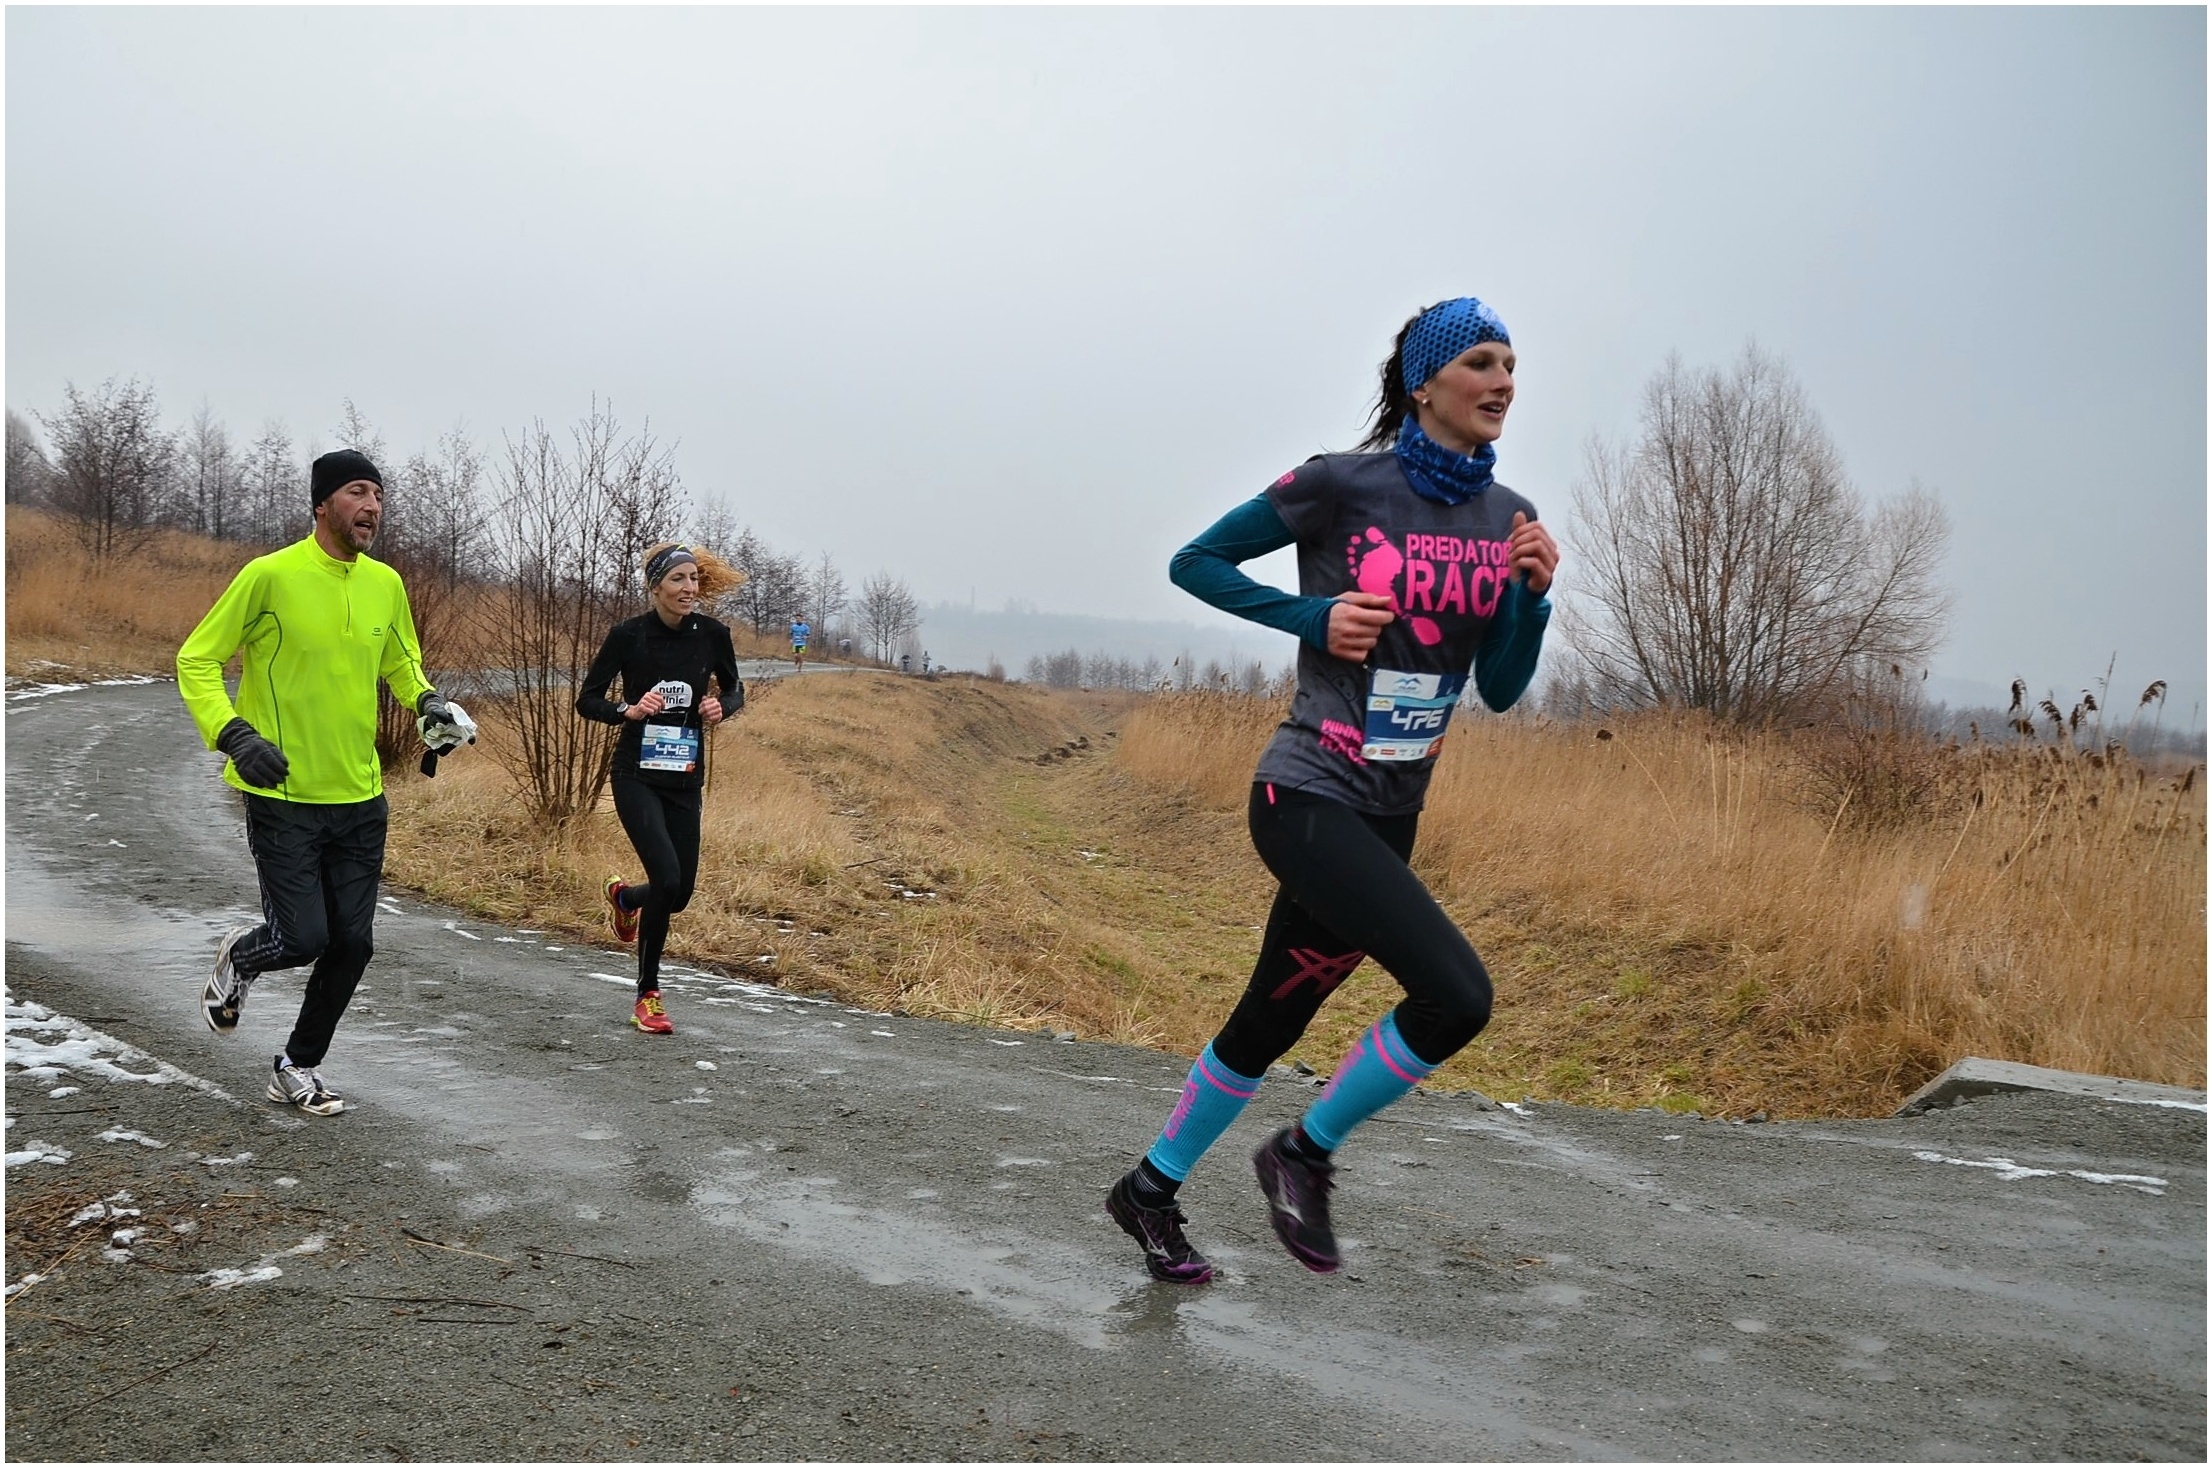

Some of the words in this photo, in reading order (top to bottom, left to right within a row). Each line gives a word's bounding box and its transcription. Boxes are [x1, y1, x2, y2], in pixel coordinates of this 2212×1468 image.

[659, 685, 685, 694] nutri
[1391, 708, 1445, 731] 476
[655, 744, 690, 756] 442
